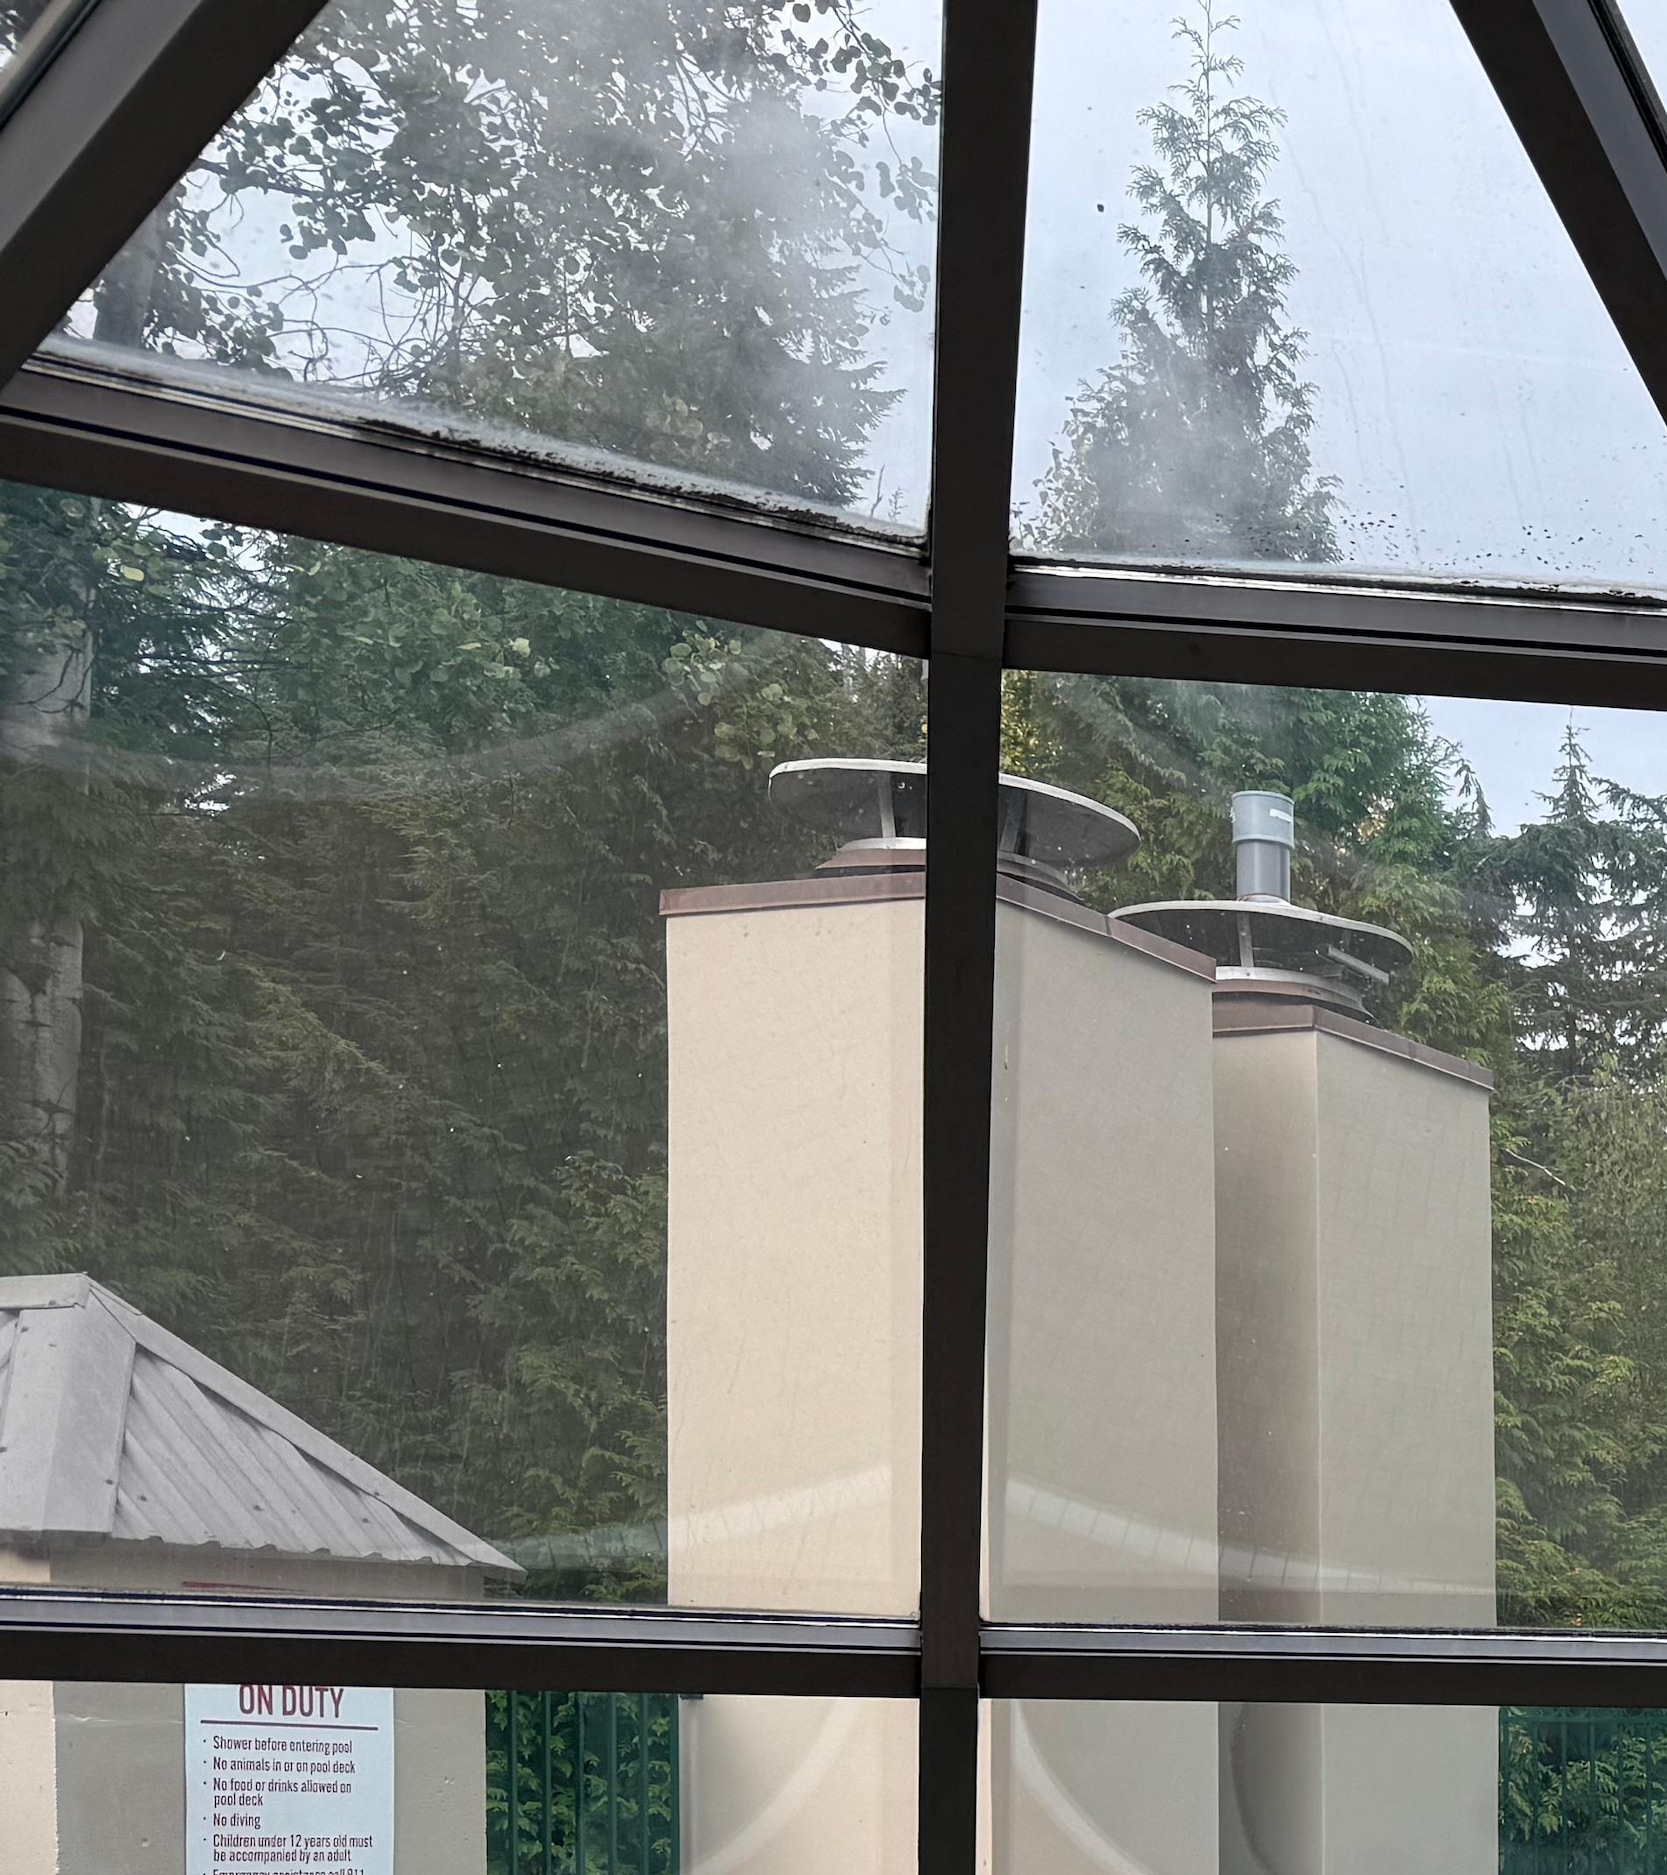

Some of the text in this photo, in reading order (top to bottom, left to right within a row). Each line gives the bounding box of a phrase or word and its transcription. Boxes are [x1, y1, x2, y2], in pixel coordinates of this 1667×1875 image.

[239, 1684, 344, 1718] ON DUTY
[213, 1735, 353, 1756] Shower before entering pool
[213, 1756, 356, 1775] No animals in or on pool deck
[213, 1777, 352, 1793] No food or drinks allowed on
[214, 1792, 263, 1808] pool deck
[213, 1813, 261, 1830] No diving
[213, 1834, 373, 1850] Children under 12 years old must
[213, 1848, 352, 1864] be accompanied by an adult
